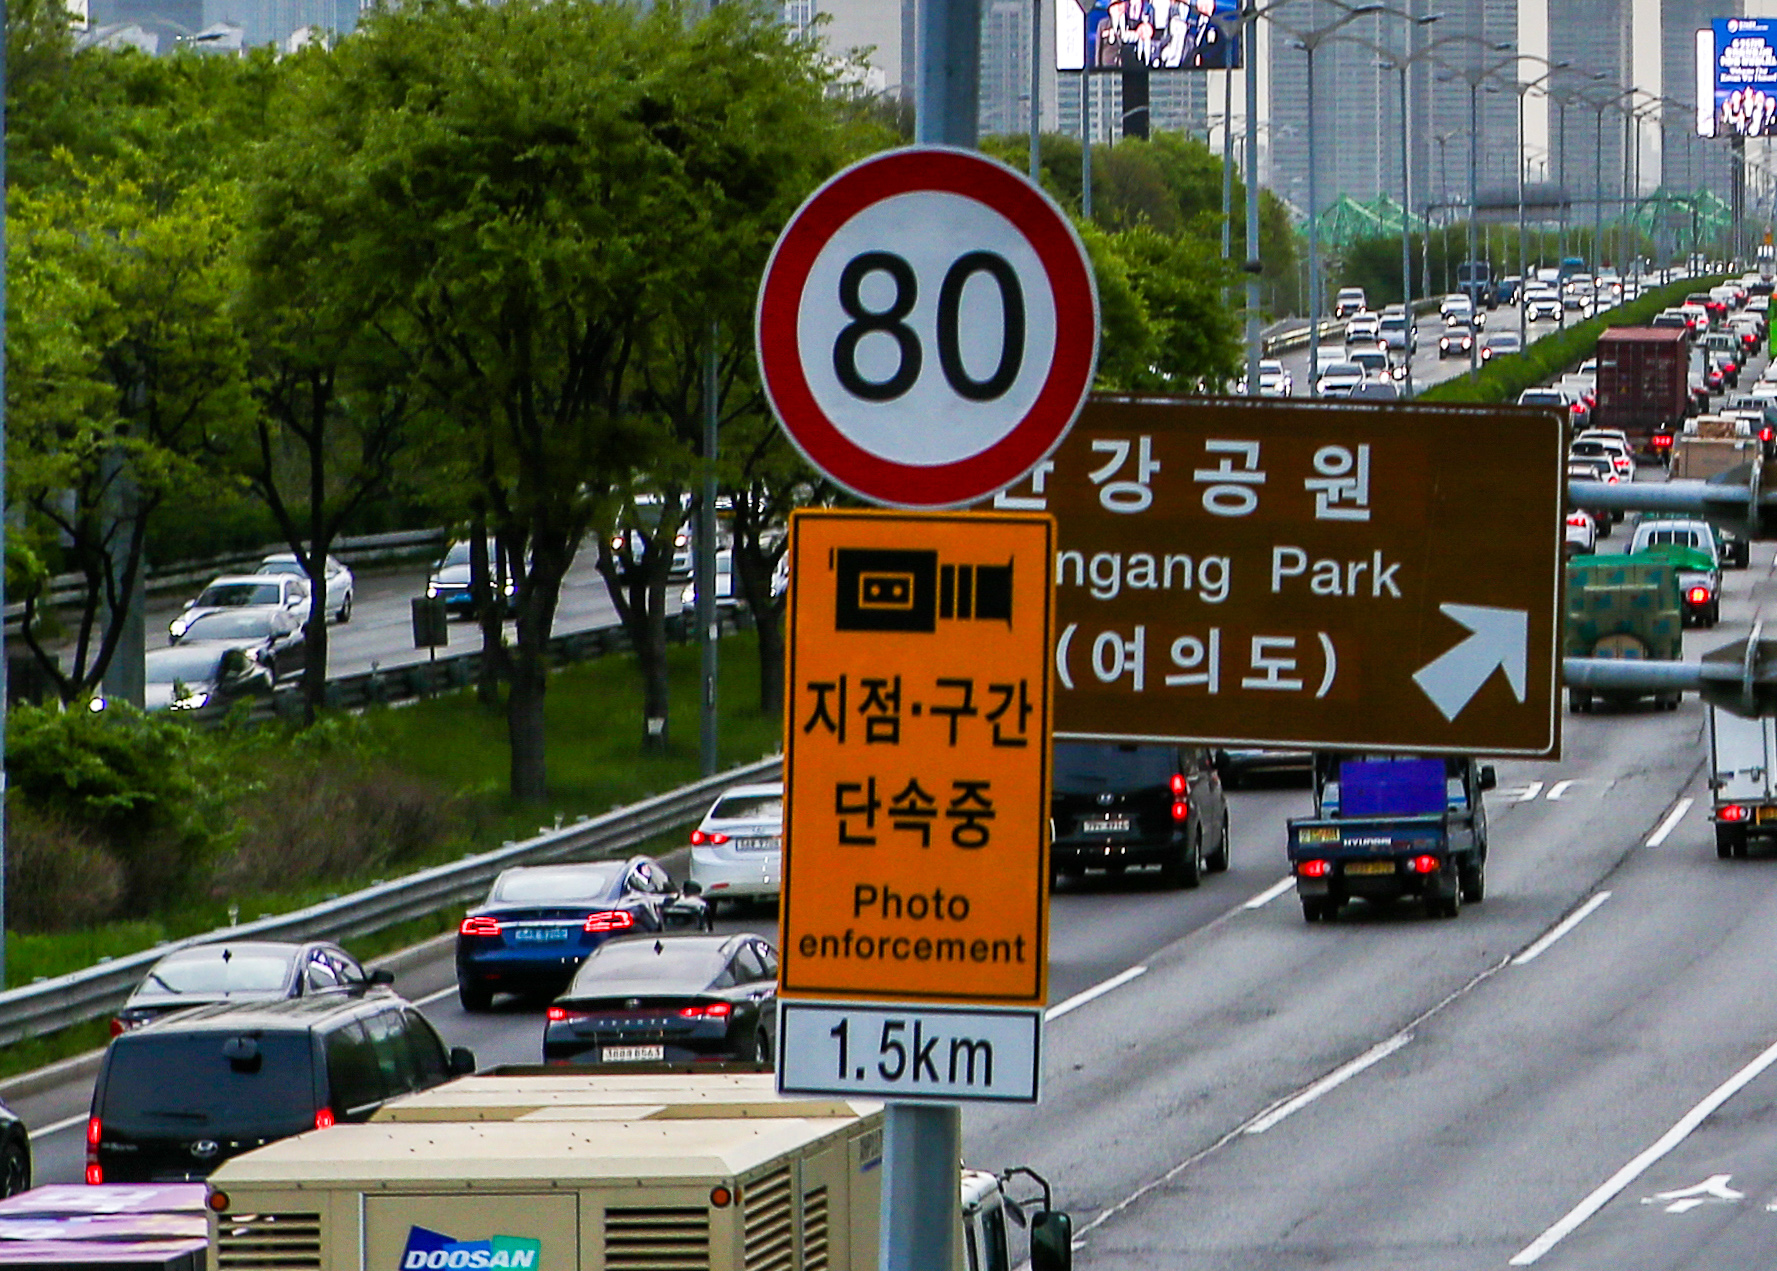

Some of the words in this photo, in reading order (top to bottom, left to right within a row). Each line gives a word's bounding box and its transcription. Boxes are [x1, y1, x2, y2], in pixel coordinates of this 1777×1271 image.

[833, 250, 1028, 401] 80
[1055, 550, 1230, 603] ngang
[1272, 547, 1402, 597] Park
[1055, 624, 1336, 698] (여의도)
[803, 673, 1034, 749] 지점·구간
[834, 776, 996, 850] 단속중
[853, 883, 971, 924] Photo
[798, 927, 1027, 966] enforcement
[830, 1017, 995, 1088] 1.5km
[404, 1250, 536, 1269] DOOSAN
